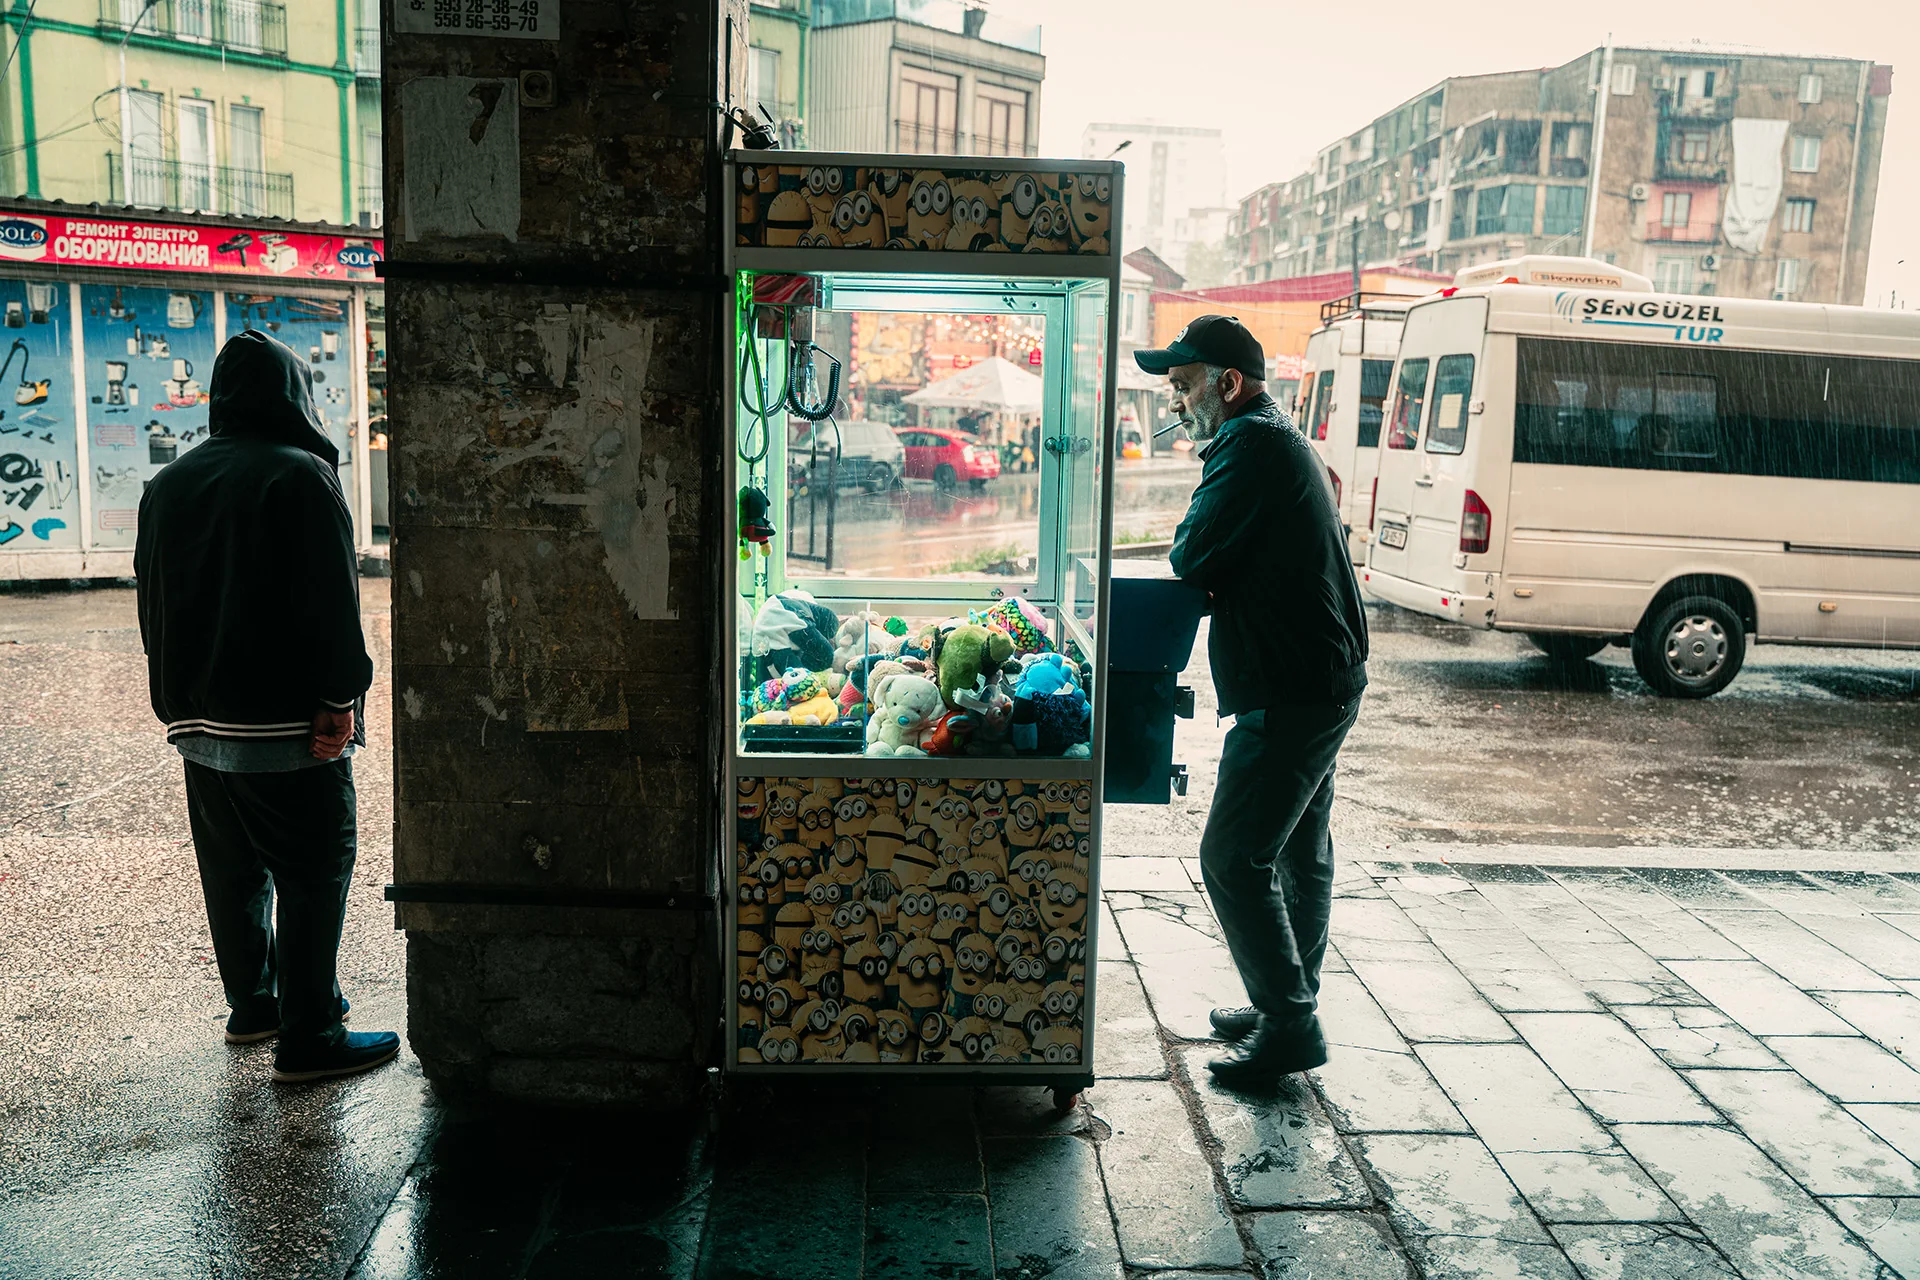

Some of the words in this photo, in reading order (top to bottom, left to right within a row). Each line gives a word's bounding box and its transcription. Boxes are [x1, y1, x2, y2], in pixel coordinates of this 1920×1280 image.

[434, 0, 461, 12] 593
[465, 0, 539, 16] 28-38-49
[434, 13, 461, 28] 558
[465, 14, 538, 32] 56-59-70
[65, 221, 129, 239] РЕМОНТ
[131, 225, 199, 243] ЭЛЕКТРО
[54, 235, 210, 267] ОБОРУДОВАНИЯ
[339, 251, 380, 266] SOLO
[1673, 326, 1724, 343] TUR
